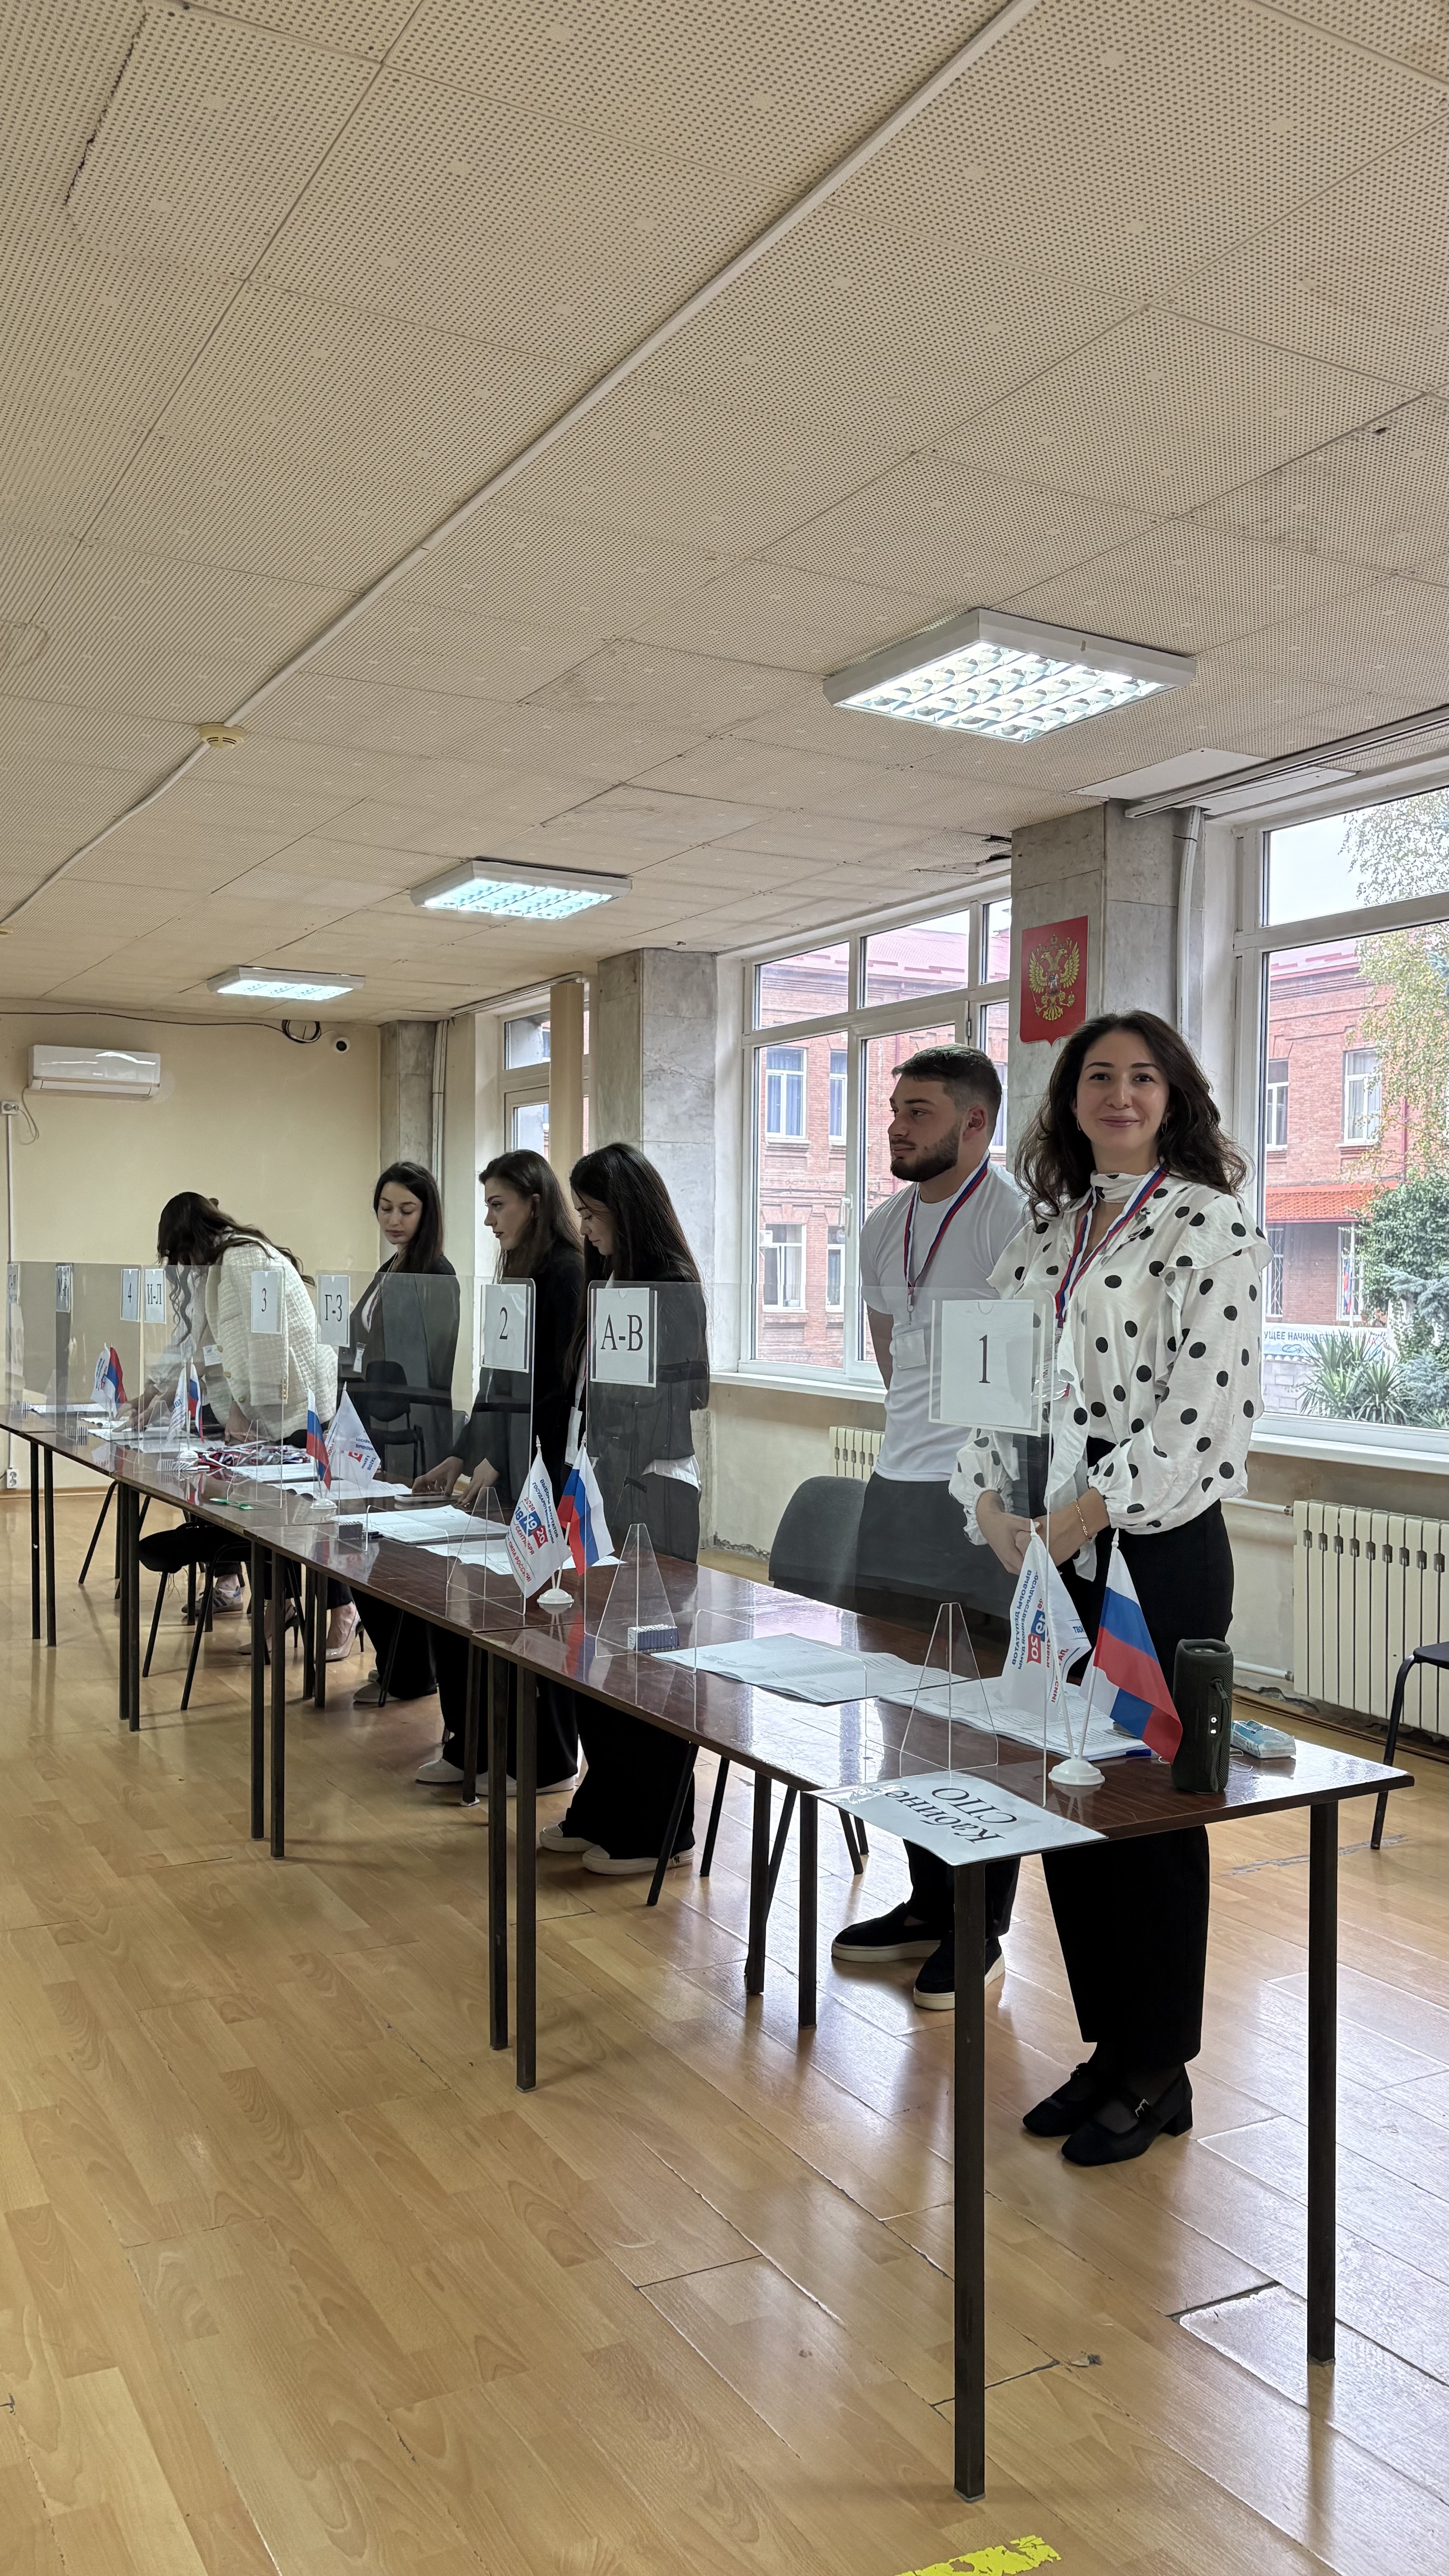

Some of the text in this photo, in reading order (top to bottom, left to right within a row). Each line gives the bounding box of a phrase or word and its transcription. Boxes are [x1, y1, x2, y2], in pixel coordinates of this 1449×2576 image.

[128, 1283, 132, 1303] 4
[147, 1283, 162, 1304] И-Л
[261, 1288, 267, 1312] 3
[324, 1294, 342, 1322] Г-З
[499, 1306, 508, 1340] 2
[600, 1314, 643, 1351] А-В
[978, 1333, 991, 1384] 1
[514, 1506, 524, 1522] 18
[524, 1515, 538, 1529] 19
[536, 1527, 546, 1544] 20
[884, 1790, 1006, 1844] Кабине
[931, 1788, 1017, 1823] СПО
